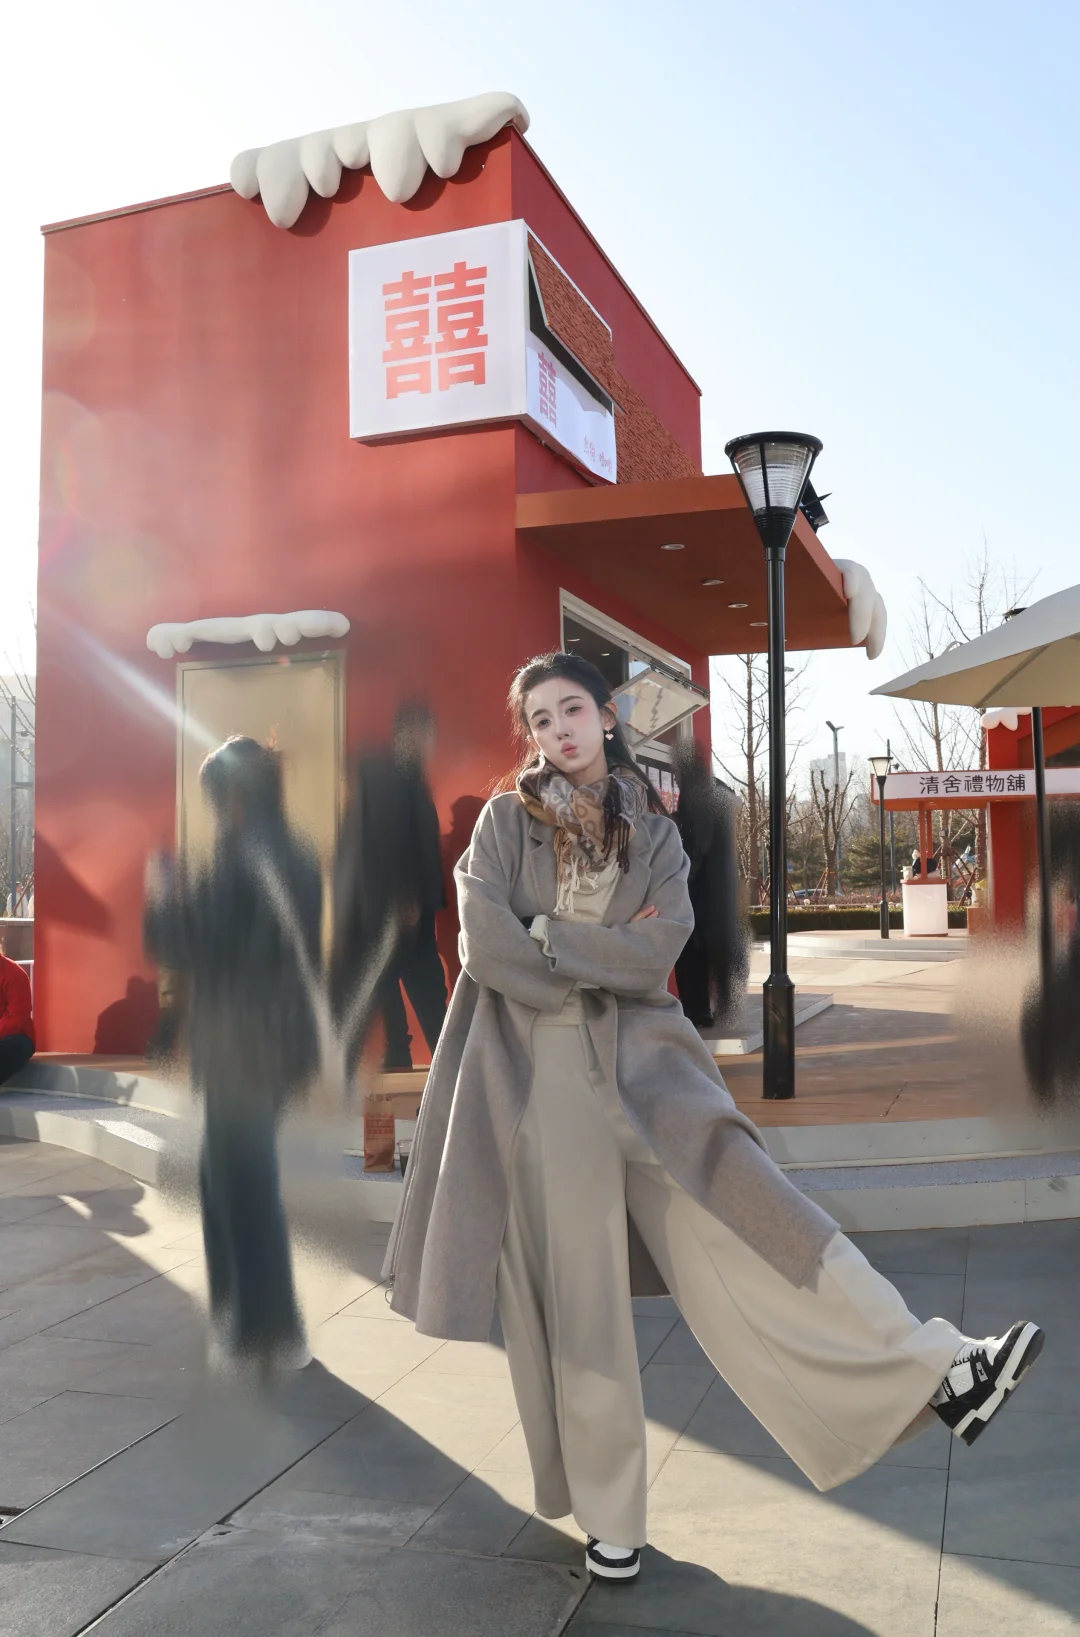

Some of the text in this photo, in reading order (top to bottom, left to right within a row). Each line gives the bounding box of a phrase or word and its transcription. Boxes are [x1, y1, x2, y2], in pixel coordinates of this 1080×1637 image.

[919, 773, 1026, 795] 清舍禮物舖
